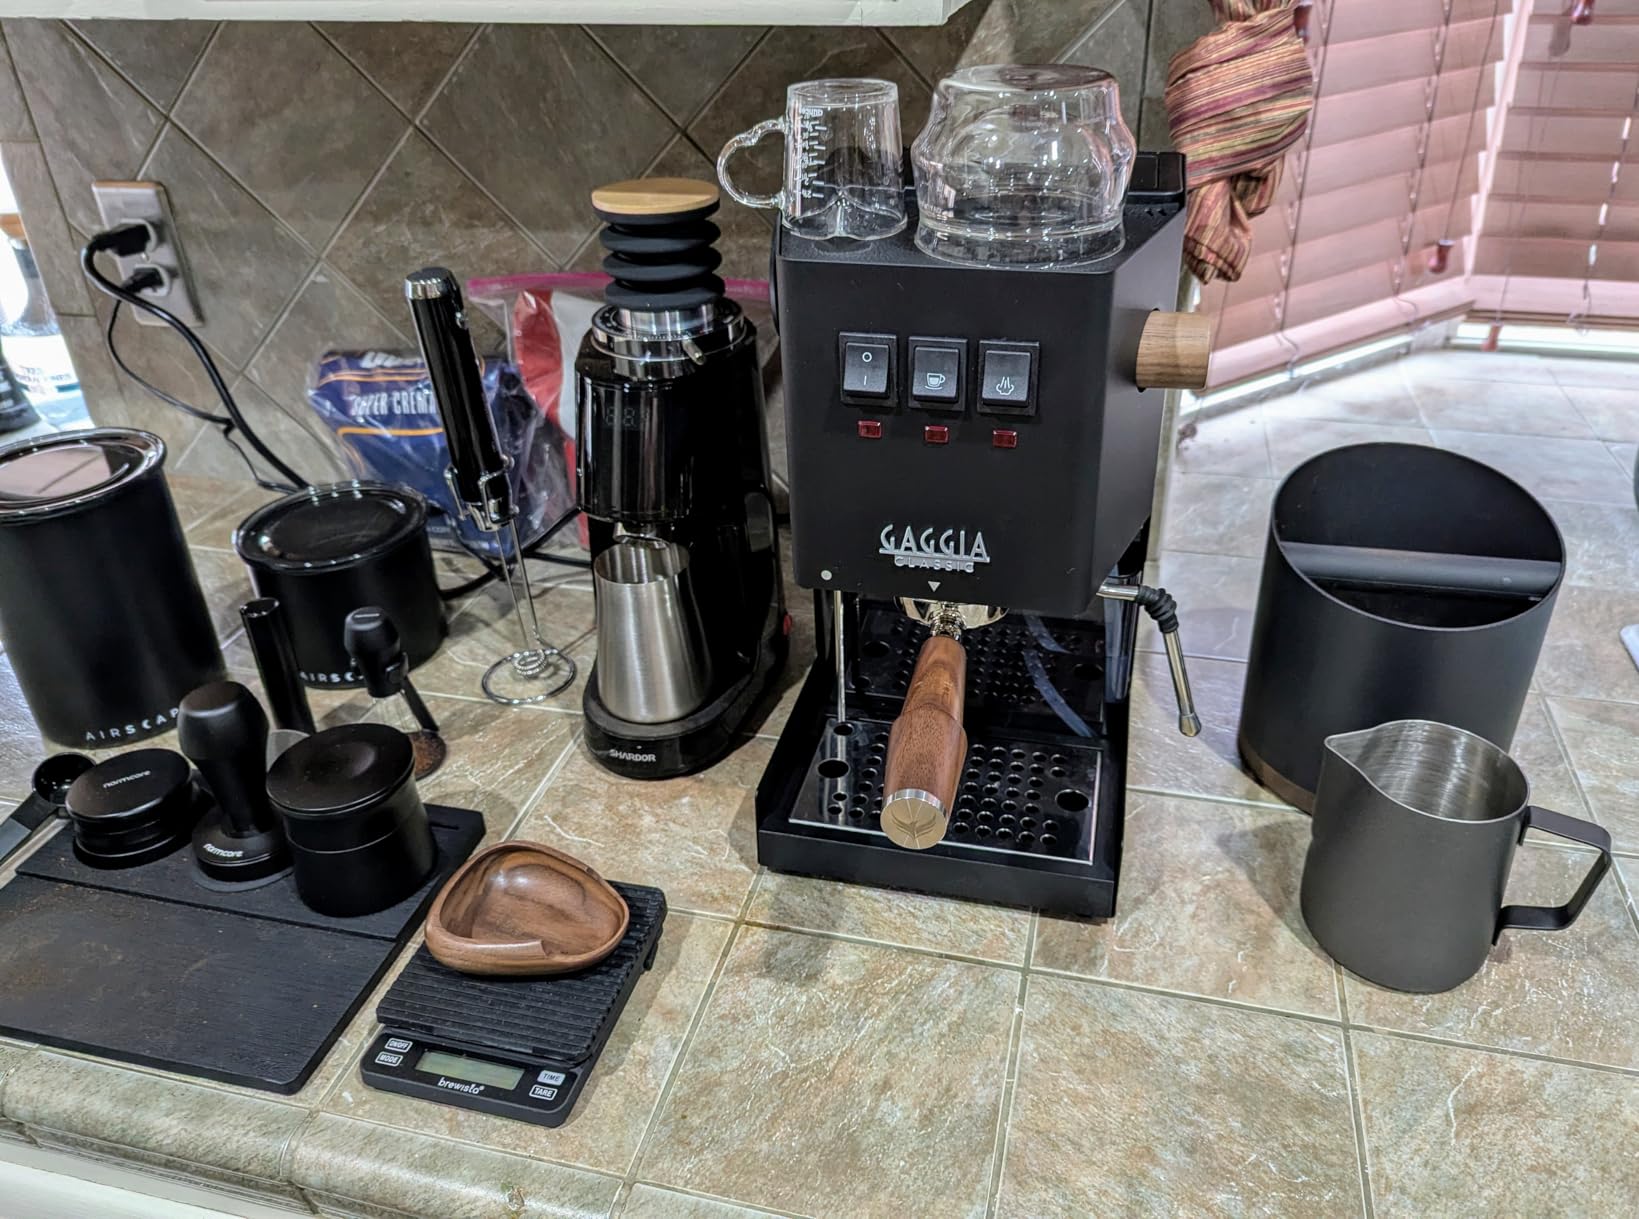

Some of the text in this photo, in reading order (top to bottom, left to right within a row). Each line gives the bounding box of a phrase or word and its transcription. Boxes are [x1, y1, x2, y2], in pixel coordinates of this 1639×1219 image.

[880, 524, 989, 560] GAGGIA
[894, 555, 975, 573] CLASSIC
[609, 749, 656, 762] SHARDOR
[102, 770, 151, 789] normcore
[203, 843, 244, 857] normcore
[389, 1040, 409, 1049] ON/OFF
[379, 1054, 399, 1063] MODE
[543, 1072, 560, 1081] TIME
[534, 1086, 553, 1097] TARE
